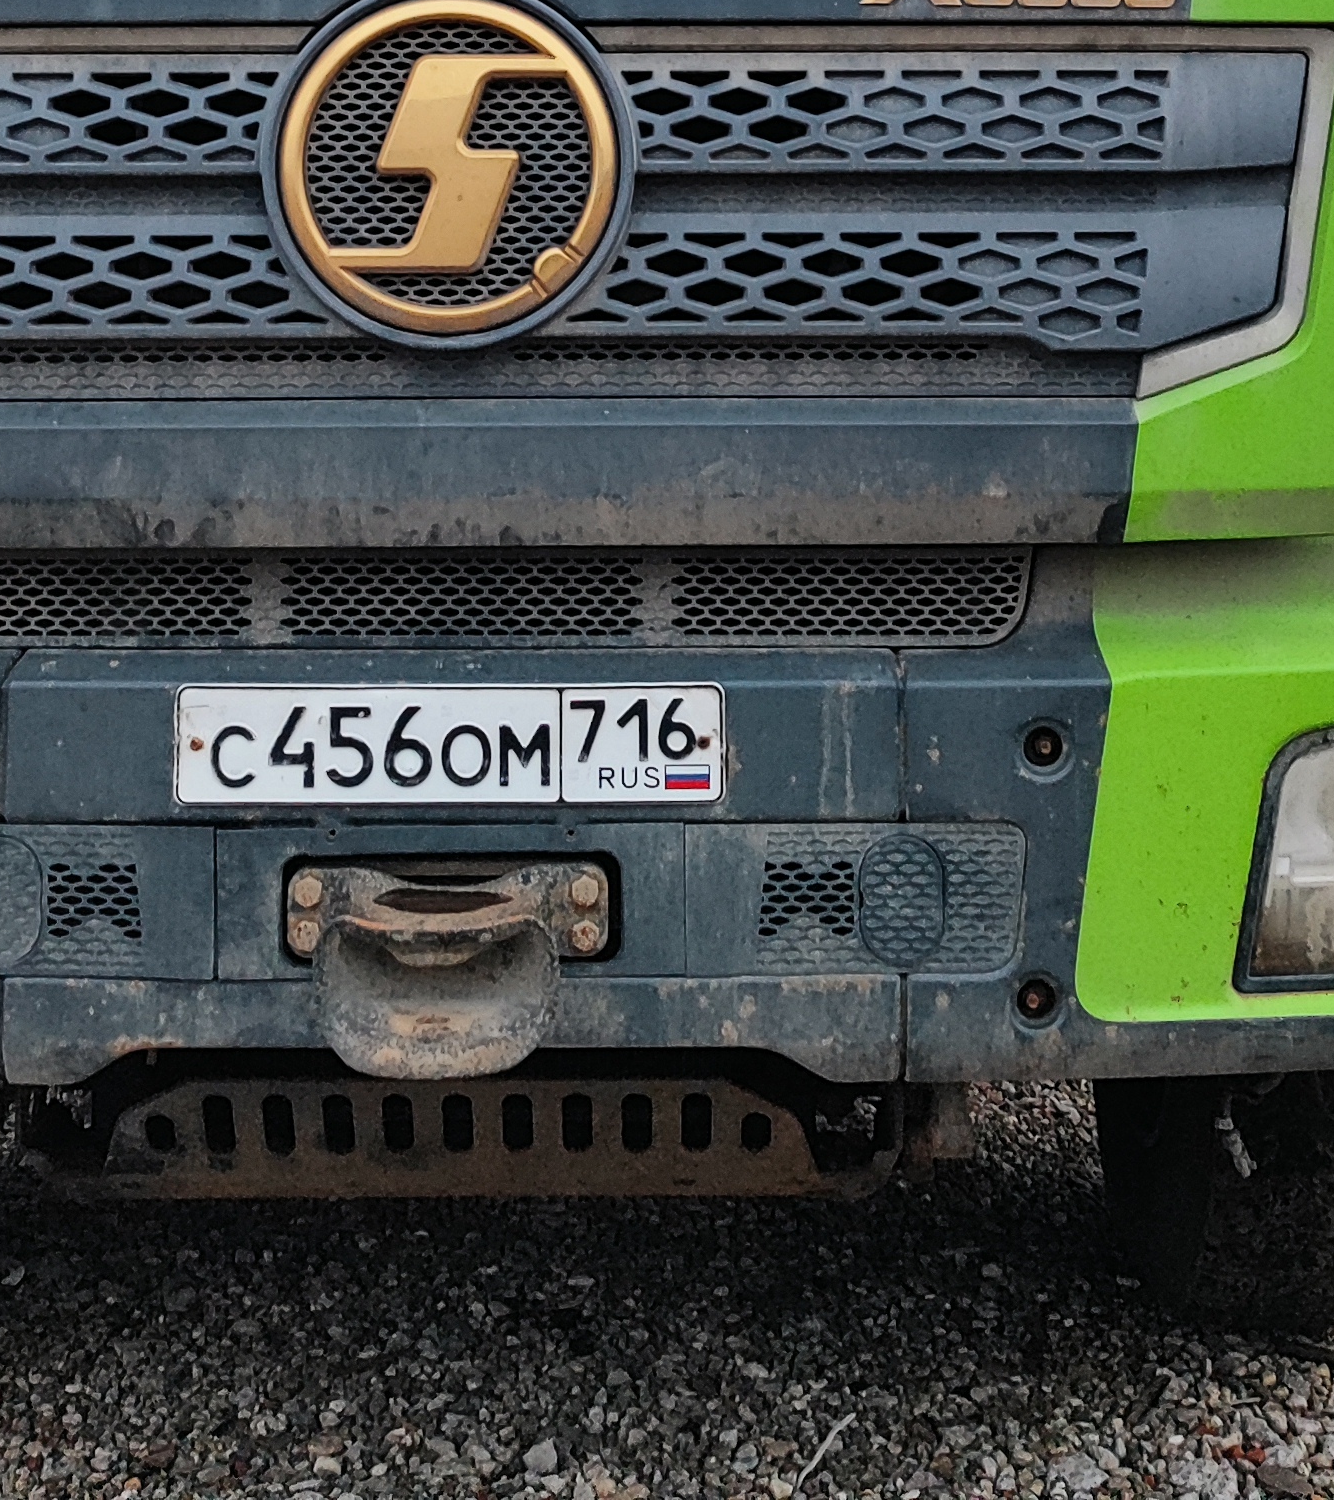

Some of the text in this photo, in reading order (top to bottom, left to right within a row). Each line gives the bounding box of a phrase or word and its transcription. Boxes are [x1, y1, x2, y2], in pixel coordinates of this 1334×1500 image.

[210, 697, 698, 789] С456ОМ 716
[598, 766, 661, 790] RUS
